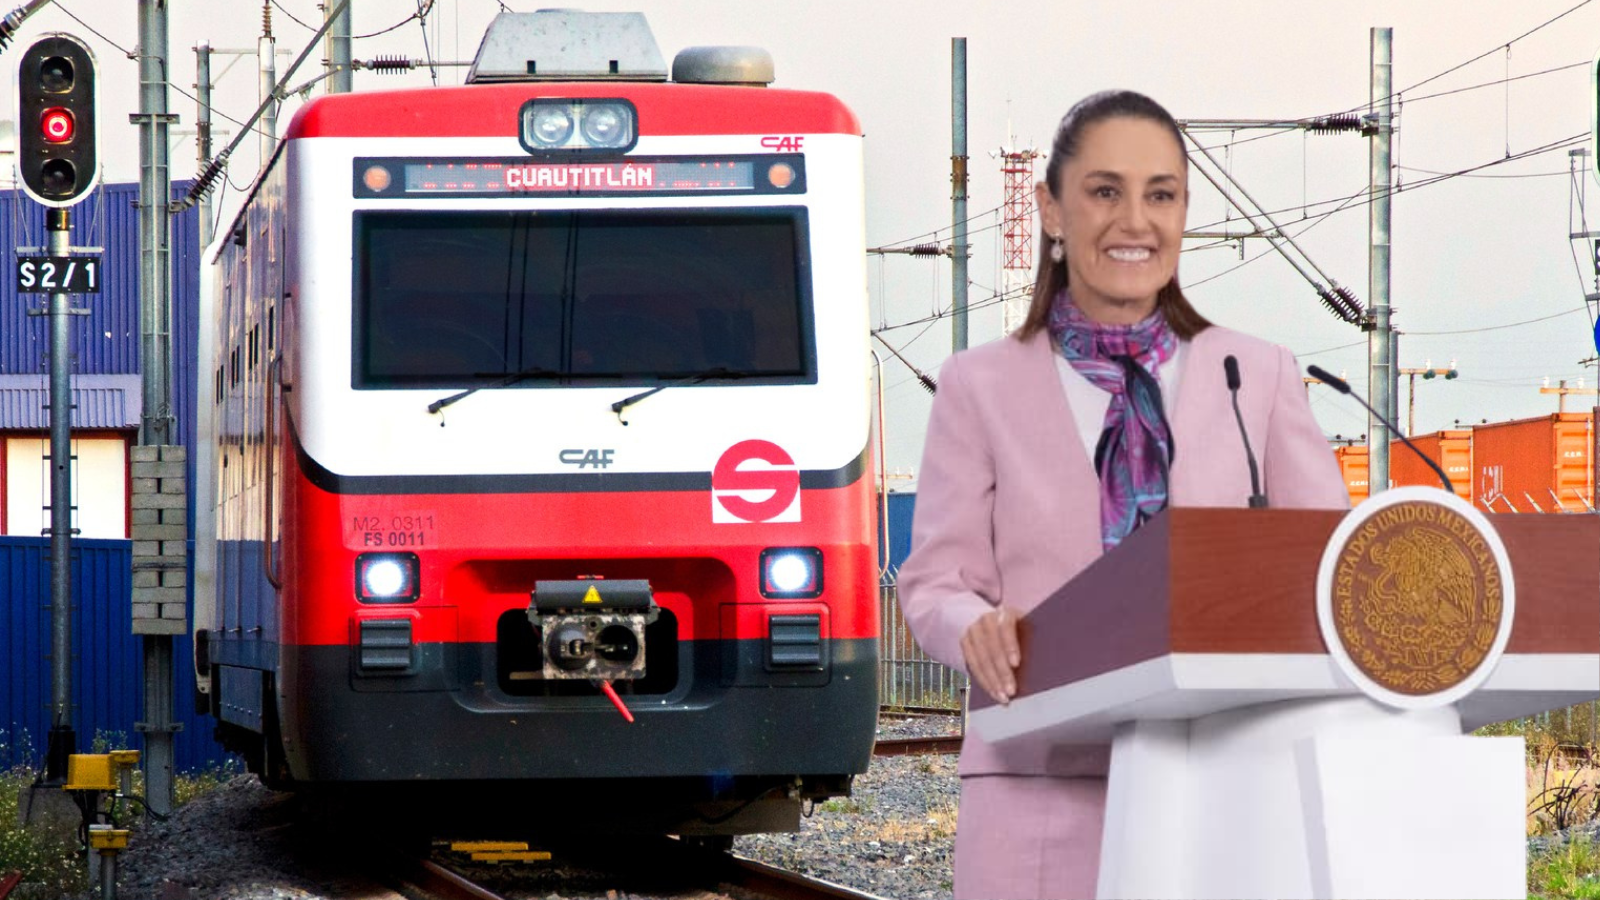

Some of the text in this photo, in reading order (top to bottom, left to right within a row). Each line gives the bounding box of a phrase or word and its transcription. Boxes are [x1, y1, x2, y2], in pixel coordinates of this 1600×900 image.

[760, 136, 804, 152] CAF
[506, 163, 653, 187] CUAUTITLÁN
[20, 262, 96, 288] S2/1
[558, 448, 615, 469] CAF
[391, 515, 434, 531] 0311
[364, 532, 425, 546] FS 0011
[1336, 504, 1500, 598] ESTADOS UNIDOS MEXICANOS
